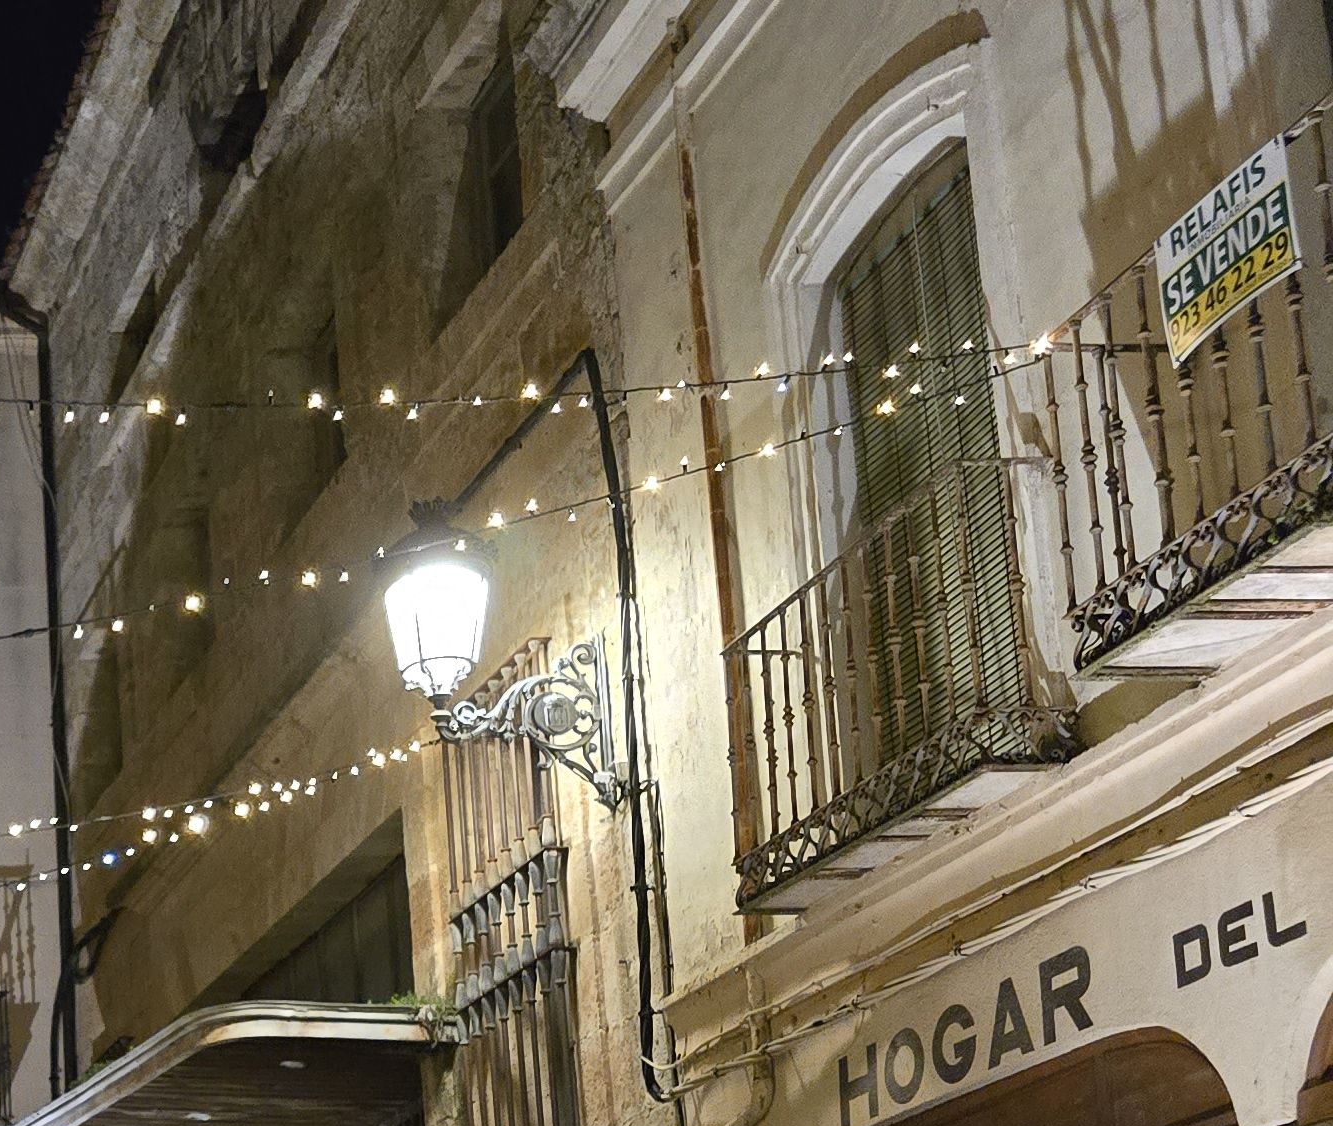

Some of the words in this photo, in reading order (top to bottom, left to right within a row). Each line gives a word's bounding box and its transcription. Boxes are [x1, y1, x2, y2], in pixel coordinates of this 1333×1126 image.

[1167, 263, 1195, 315] SE
[1196, 187, 1285, 287] VENDE
[1170, 154, 1265, 257] RELAFIS
[1171, 301, 1201, 346] 923
[1205, 278, 1227, 312] 46
[1231, 256, 1256, 293] 22
[1261, 231, 1289, 270] 29
[1172, 891, 1308, 989] DEL
